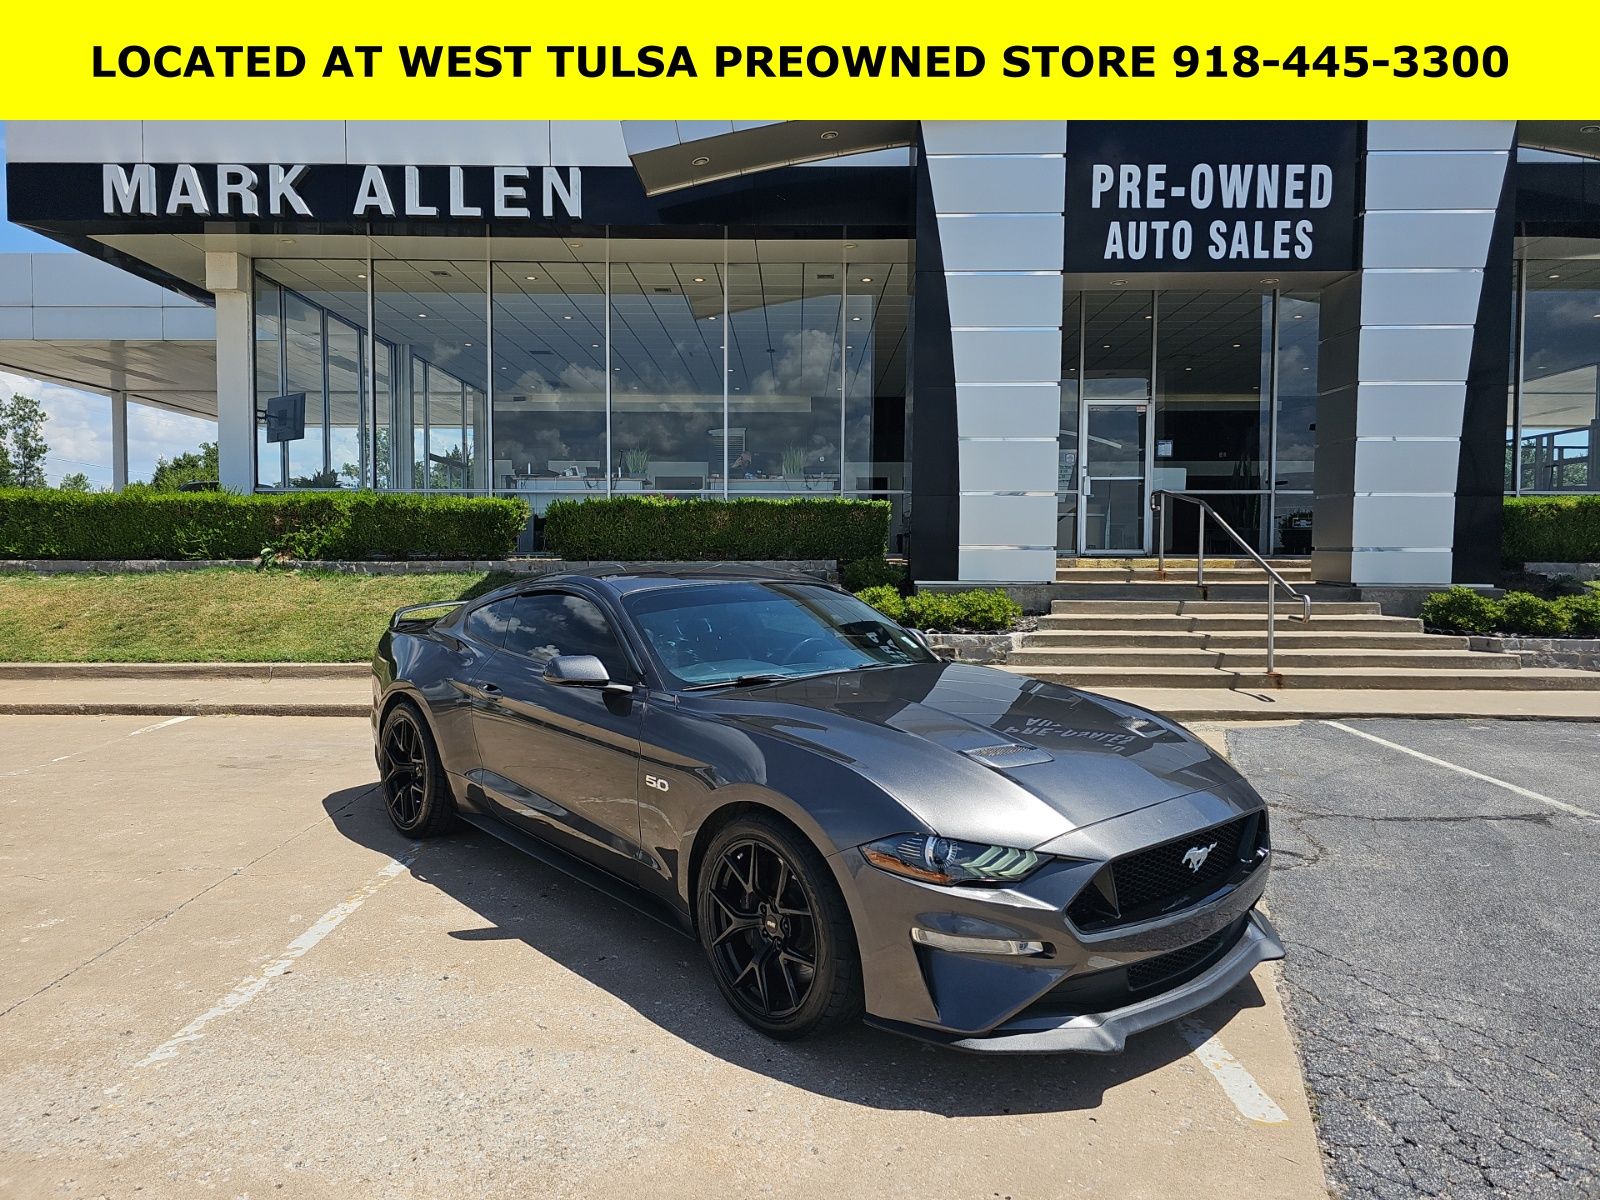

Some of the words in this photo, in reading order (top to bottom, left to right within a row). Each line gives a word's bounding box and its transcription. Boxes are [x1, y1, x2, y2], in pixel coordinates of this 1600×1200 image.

[102, 164, 313, 217] MARK
[353, 165, 584, 219] ALLEN
[1091, 163, 1334, 210] PRE-OWNED
[1104, 220, 1193, 260] AUTO
[1208, 219, 1313, 260] SALES
